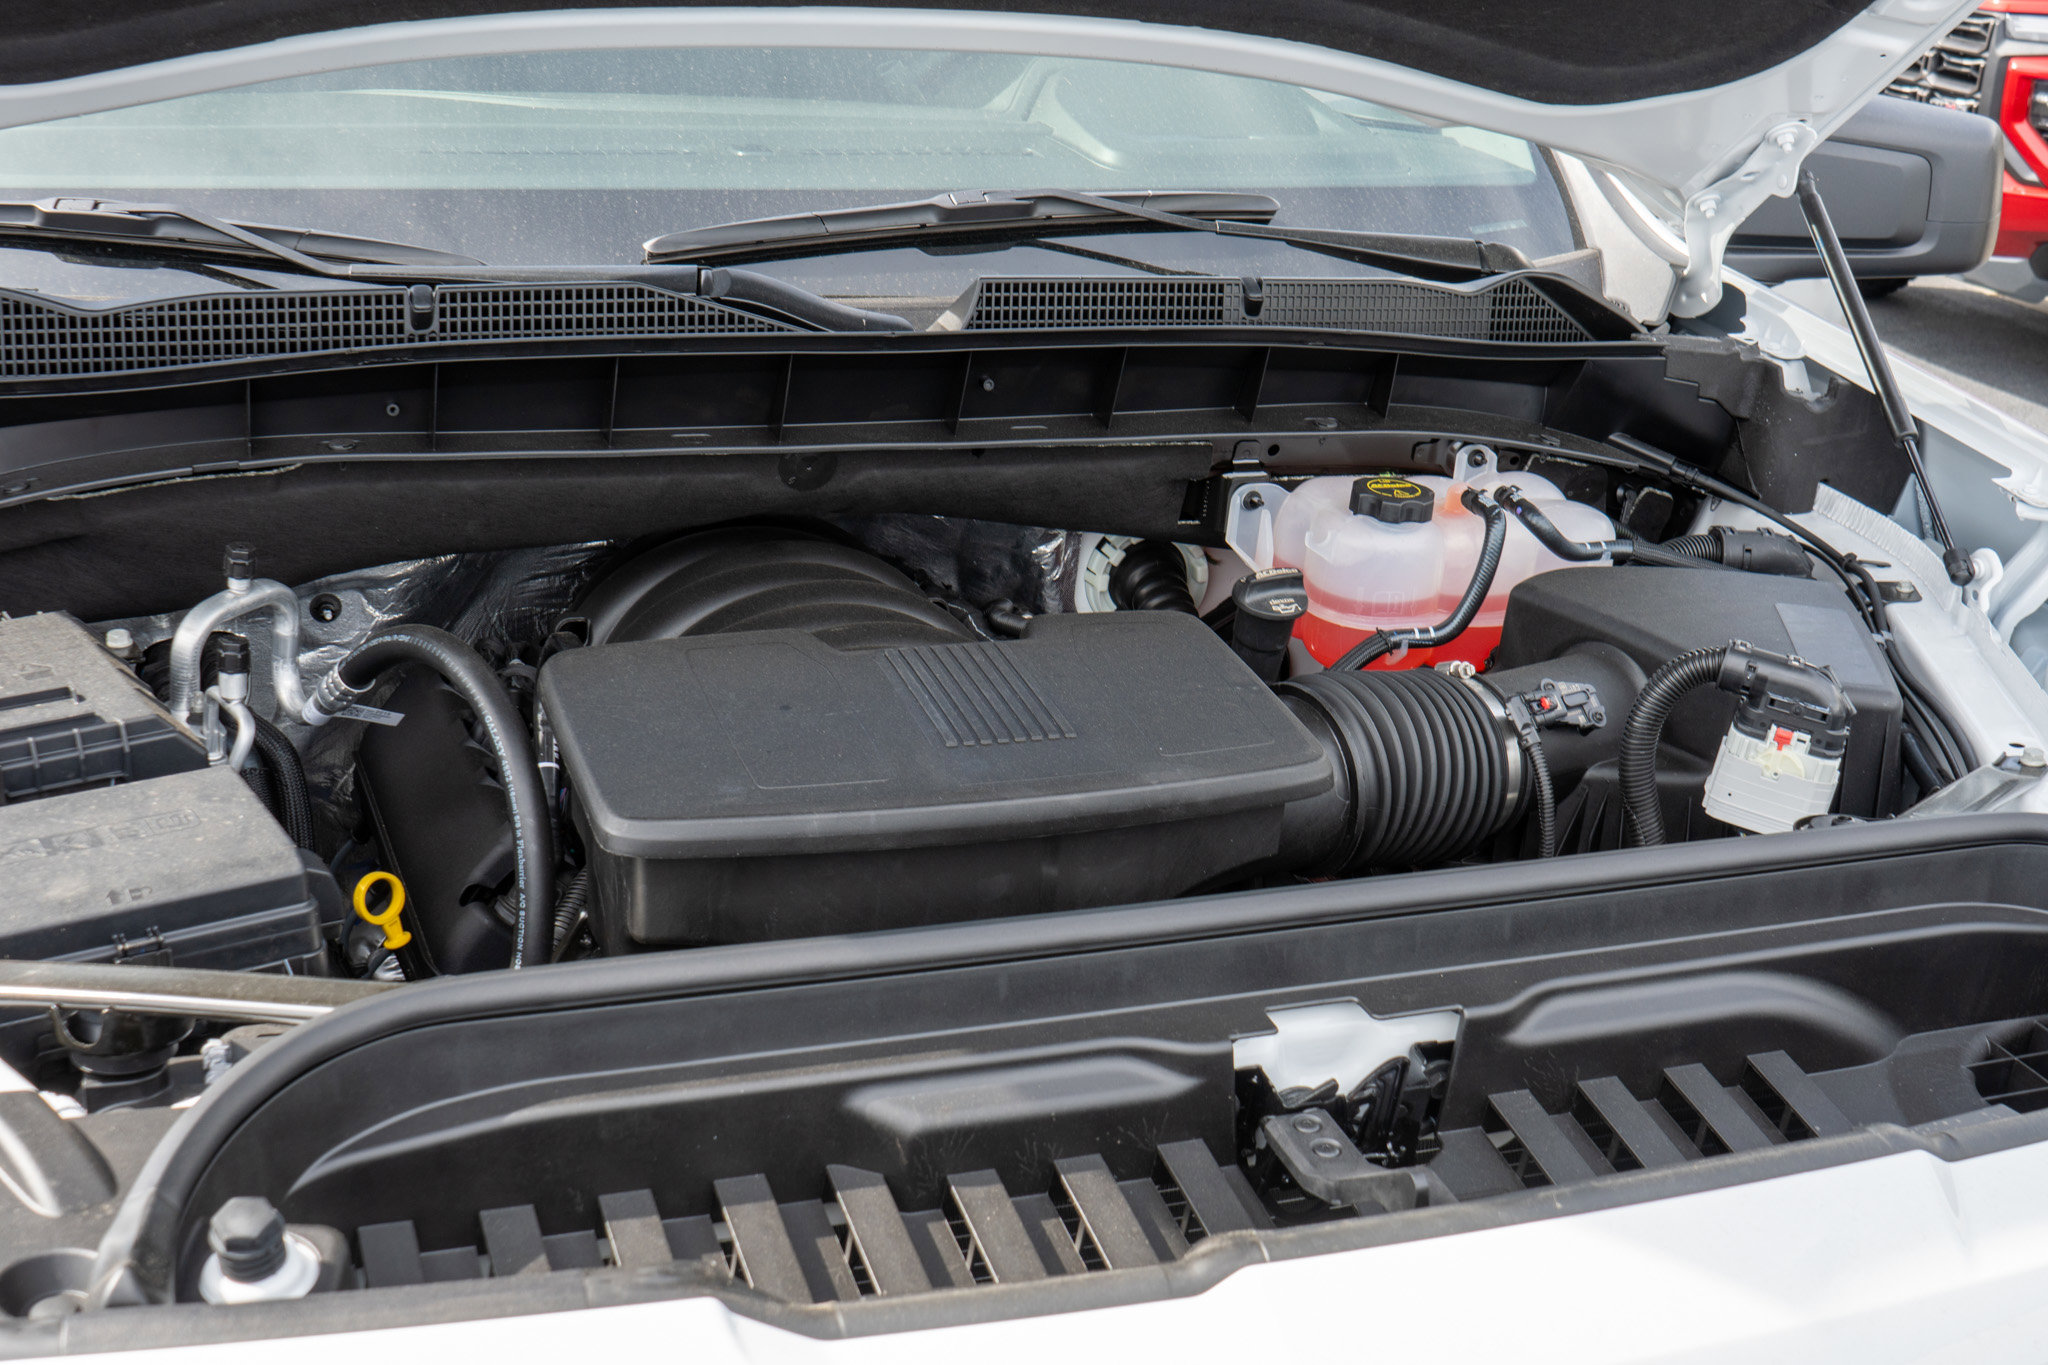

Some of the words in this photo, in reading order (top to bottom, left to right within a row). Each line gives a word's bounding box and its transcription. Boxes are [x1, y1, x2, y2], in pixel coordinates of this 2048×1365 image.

[1255, 568, 1298, 581] ACDelco
[484, 714, 506, 757] GALAXY
[516, 840, 526, 889] Flexbarrier
[517, 910, 526, 950] SUCTION
[514, 951, 522, 970] HOS
